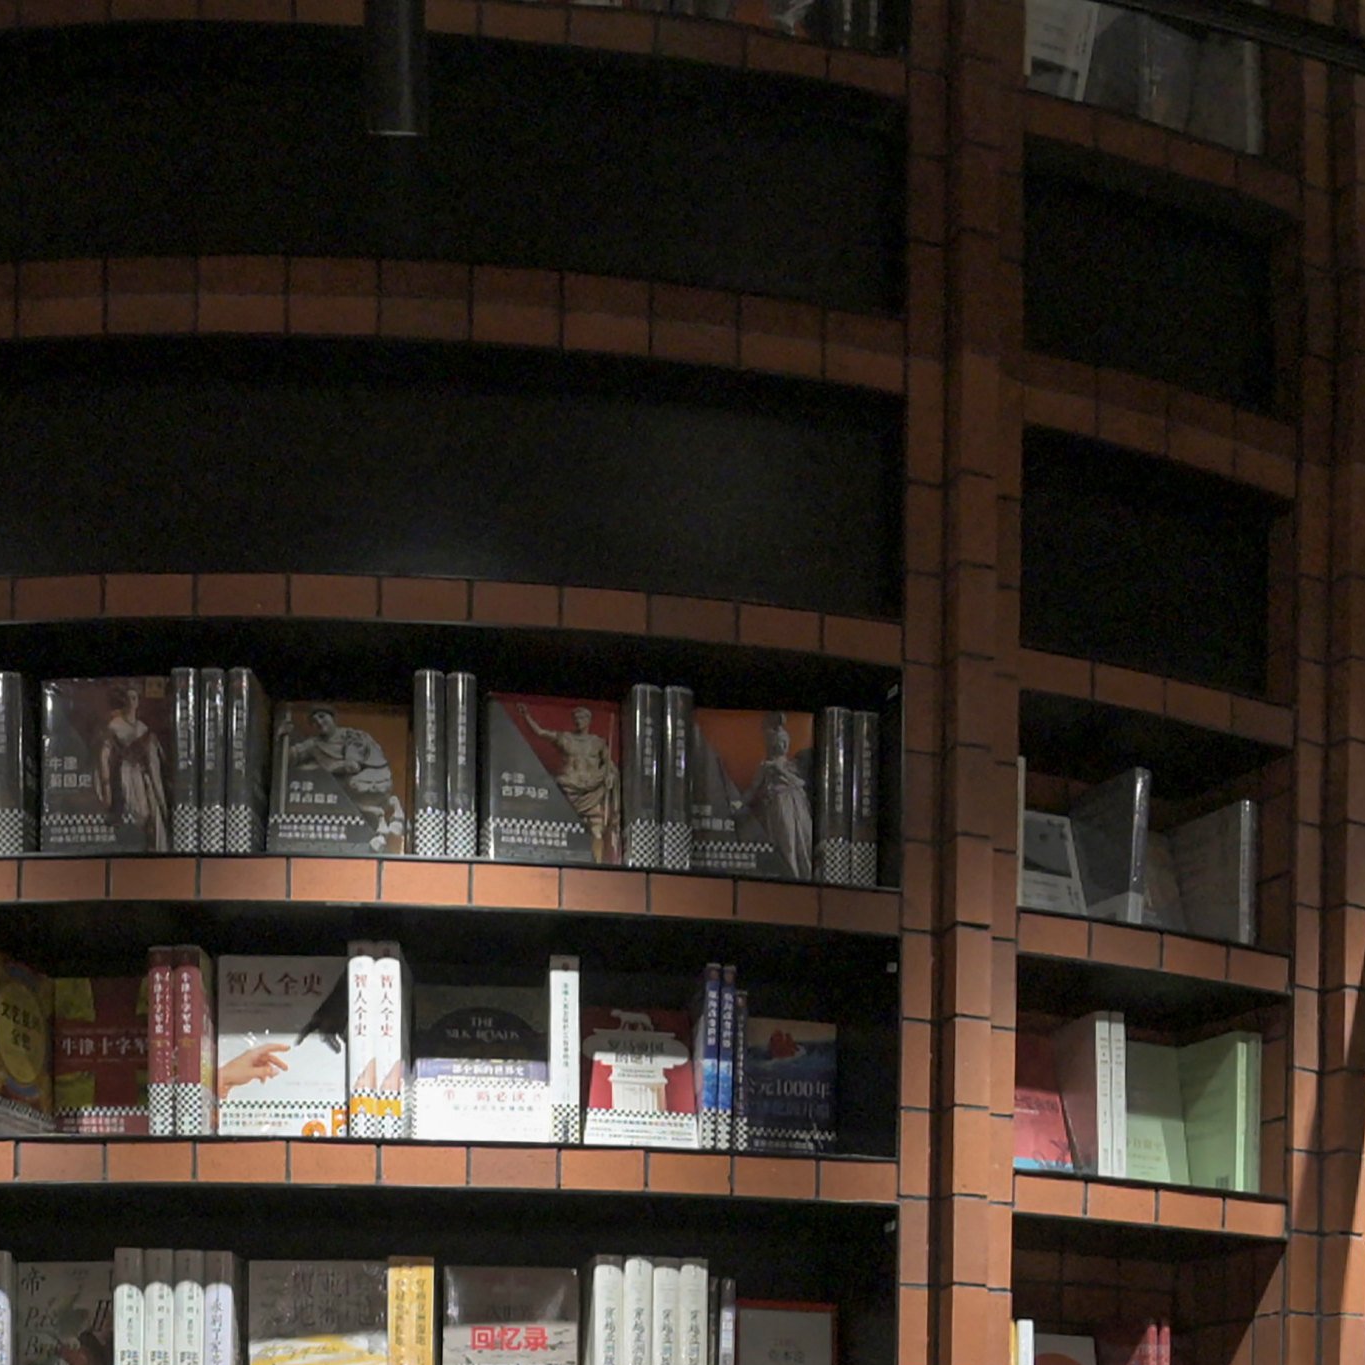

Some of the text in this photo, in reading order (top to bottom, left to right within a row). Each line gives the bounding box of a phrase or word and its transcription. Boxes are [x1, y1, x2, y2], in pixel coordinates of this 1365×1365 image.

[48, 756, 78, 771] 牛津
[49, 774, 92, 788] 英国史
[501, 771, 526, 784] 牛津
[289, 781, 314, 792] 牛津
[501, 785, 549, 800] 古罗马史
[226, 971, 323, 996] 智人全史
[354, 974, 367, 1038] 智人全史
[380, 974, 394, 1038] 智人全史
[470, 1326, 548, 1350] 回忆录
